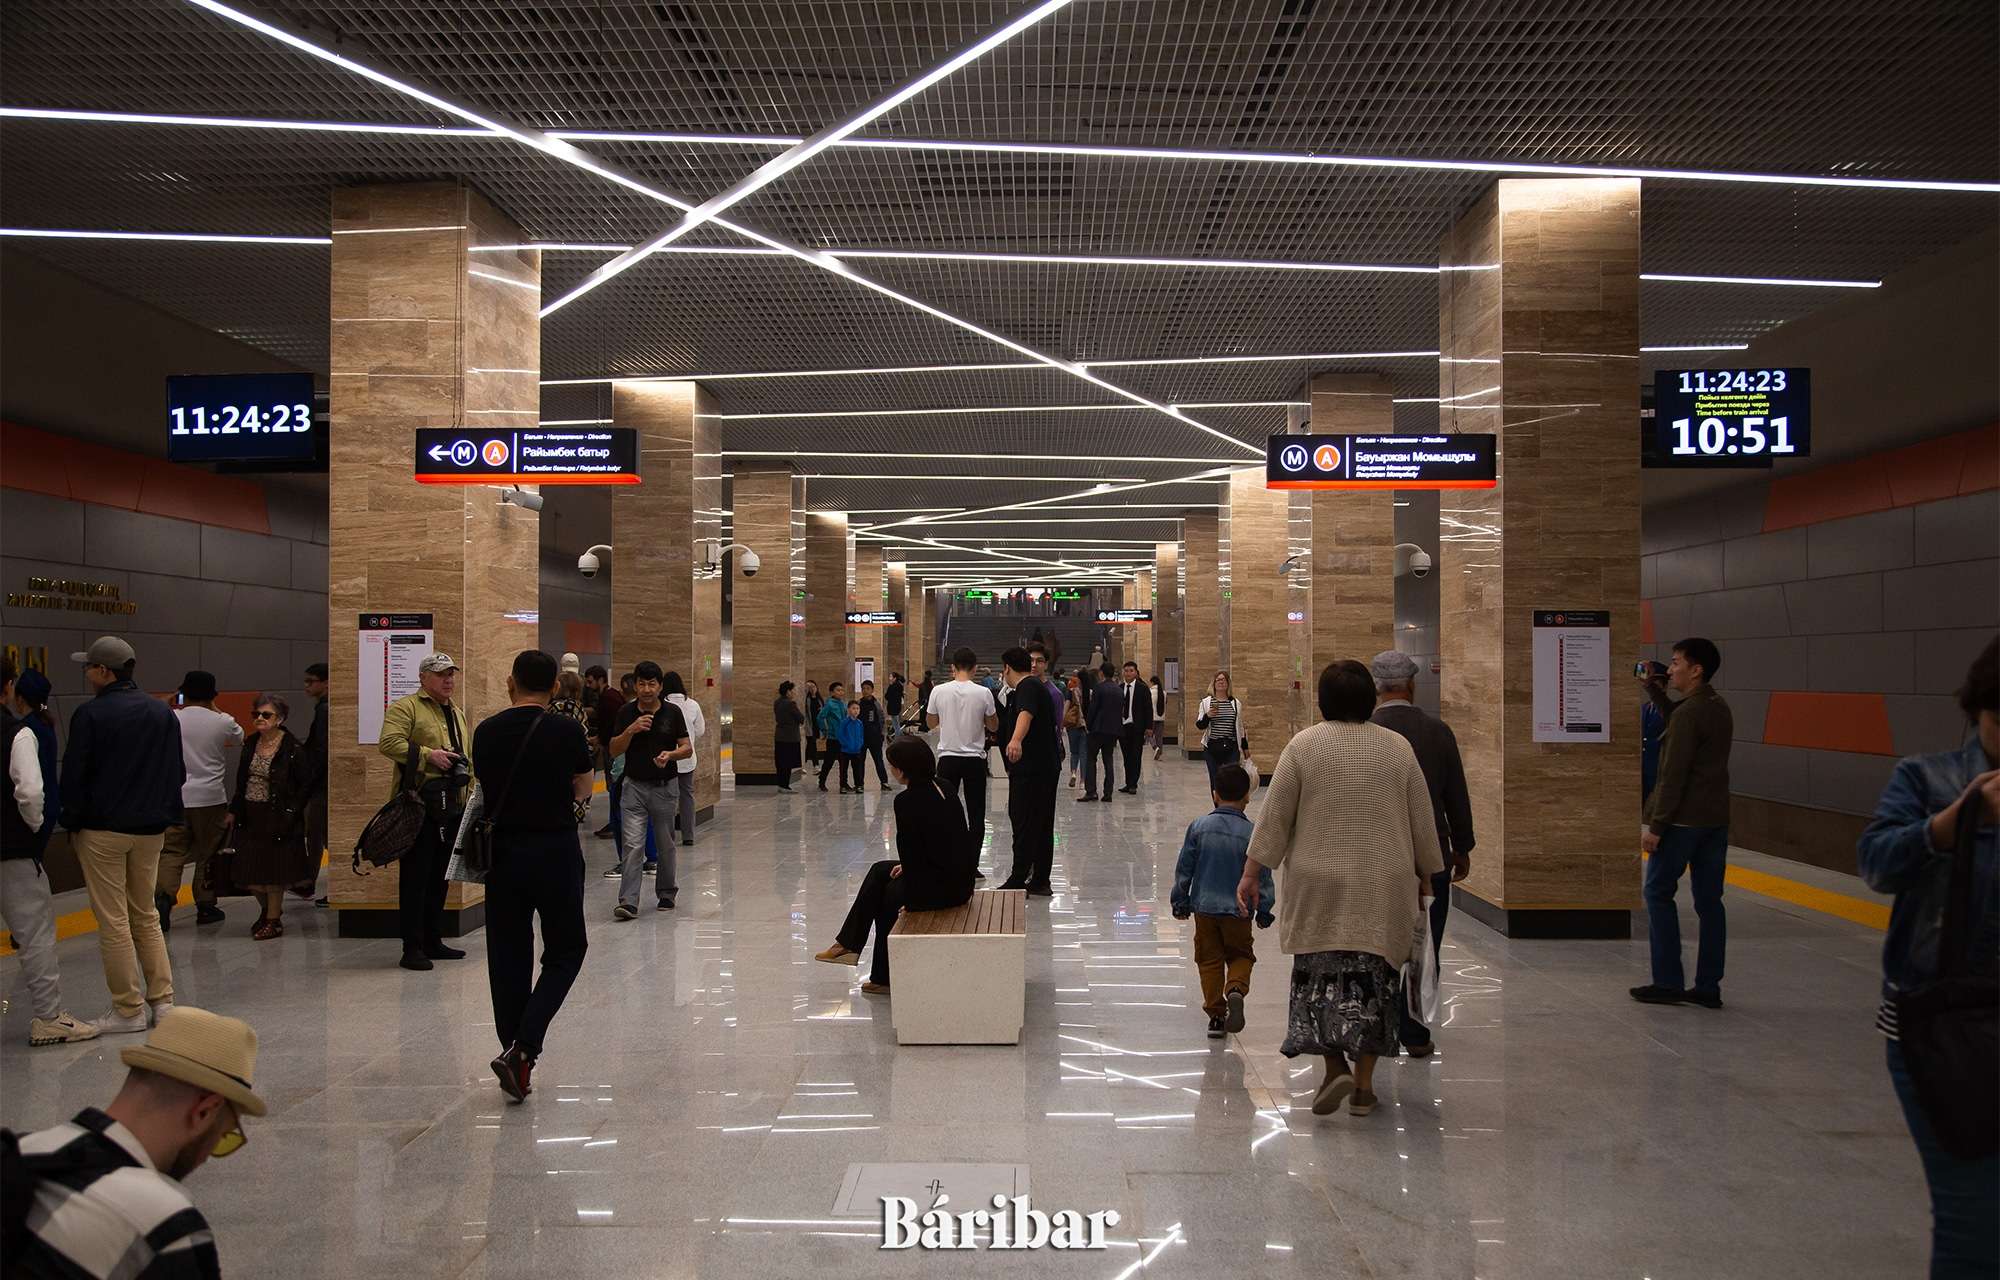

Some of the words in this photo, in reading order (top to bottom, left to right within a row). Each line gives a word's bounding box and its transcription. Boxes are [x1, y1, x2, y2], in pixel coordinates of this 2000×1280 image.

[1679, 370, 1786, 393] 11:24:23
[171, 404, 312, 435] 11:24:23
[1672, 416, 1794, 455] 10:51
[457, 446, 471, 460] M
[577, 446, 610, 459] батыр
[1287, 450, 1303, 465] M
[1355, 451, 1410, 464] Бауыржан
